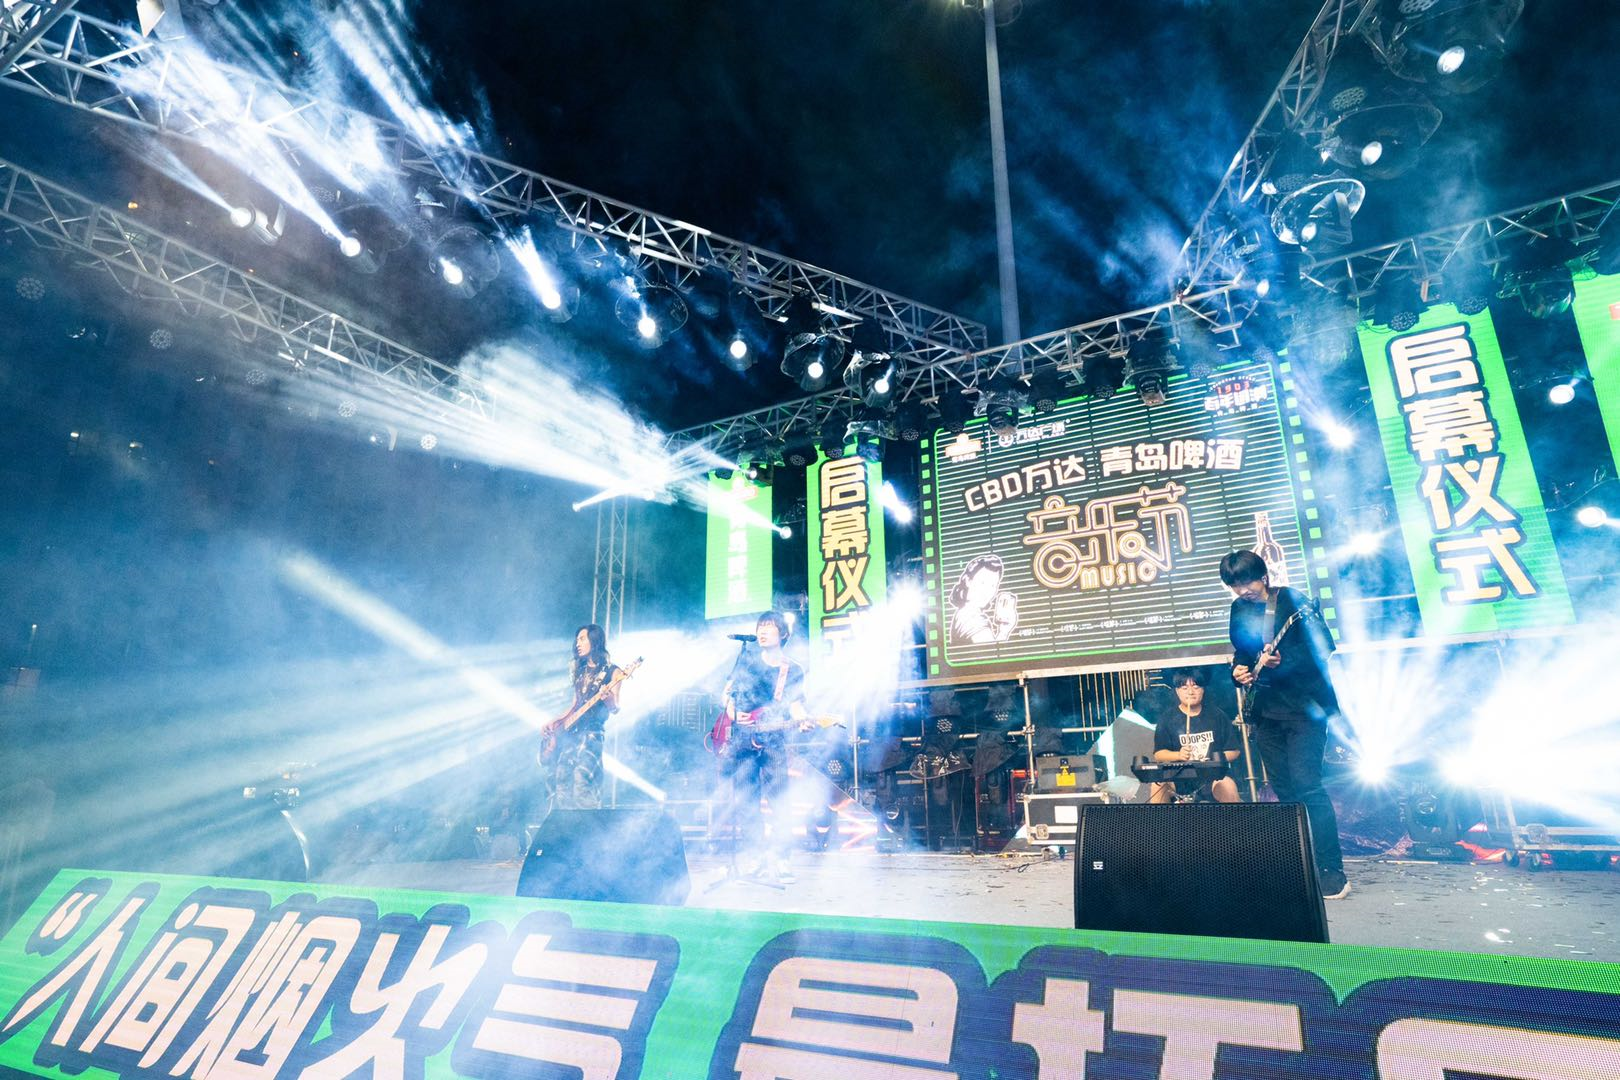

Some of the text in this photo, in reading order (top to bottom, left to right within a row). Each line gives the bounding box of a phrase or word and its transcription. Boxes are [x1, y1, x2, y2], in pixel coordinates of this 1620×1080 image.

[964, 438, 1246, 512] CBD万达 青岛啤酒
[1390, 324, 1538, 602] 启幕仪式
[1080, 560, 1158, 590] MUSIC
